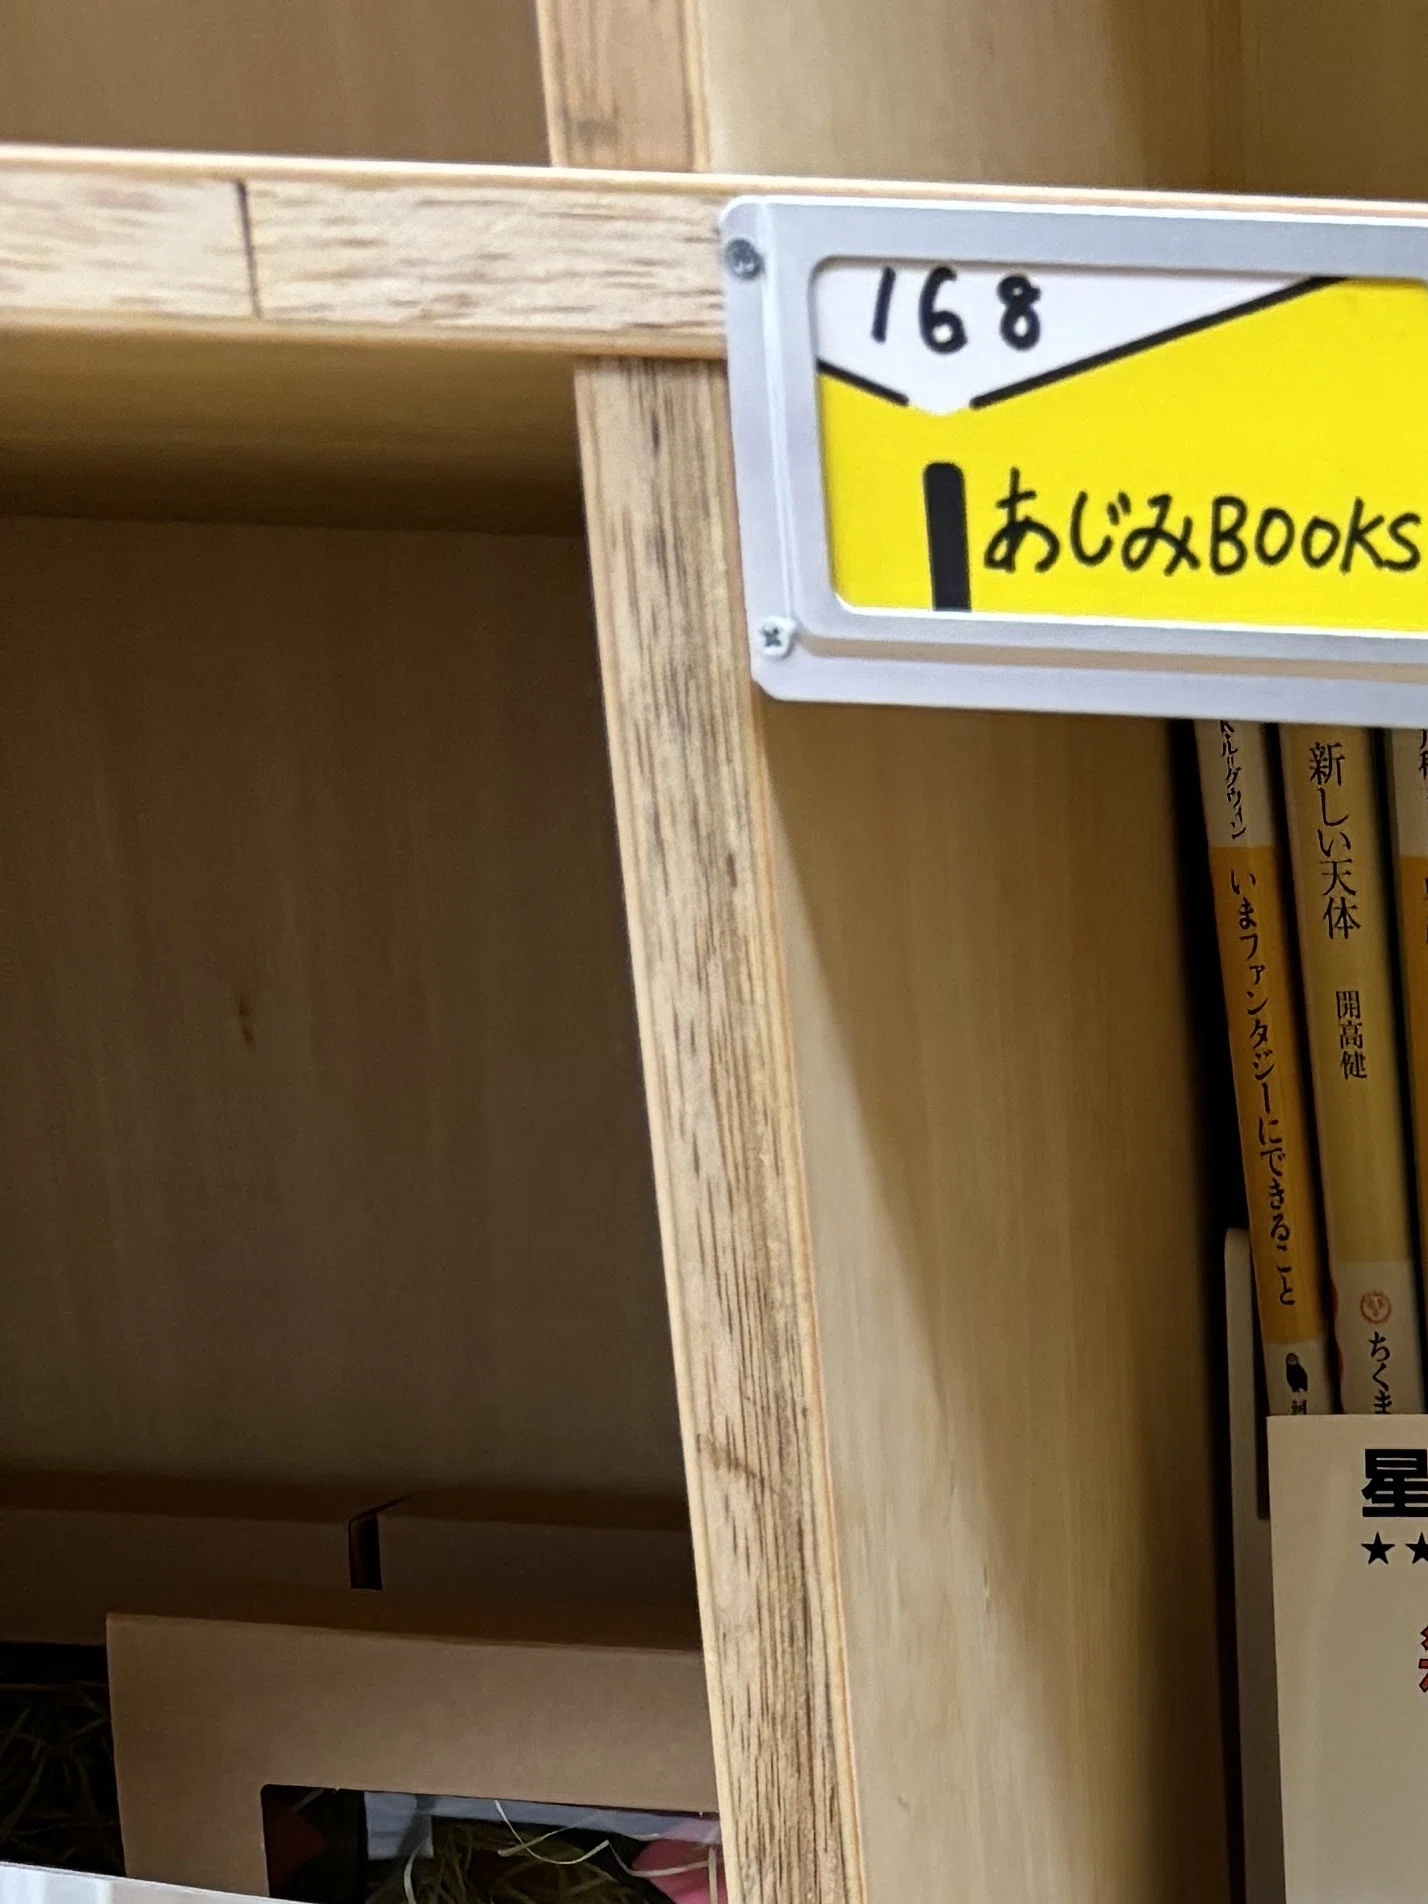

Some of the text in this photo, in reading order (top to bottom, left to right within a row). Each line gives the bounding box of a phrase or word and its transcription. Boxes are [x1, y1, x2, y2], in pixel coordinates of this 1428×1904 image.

[872, 265, 1043, 354] 168
[983, 467, 1423, 577] あじみBOOKS
[1308, 740, 1369, 1081] 新しい天体 開高健
[1230, 868, 1298, 1307] いまファンタジーにできること
